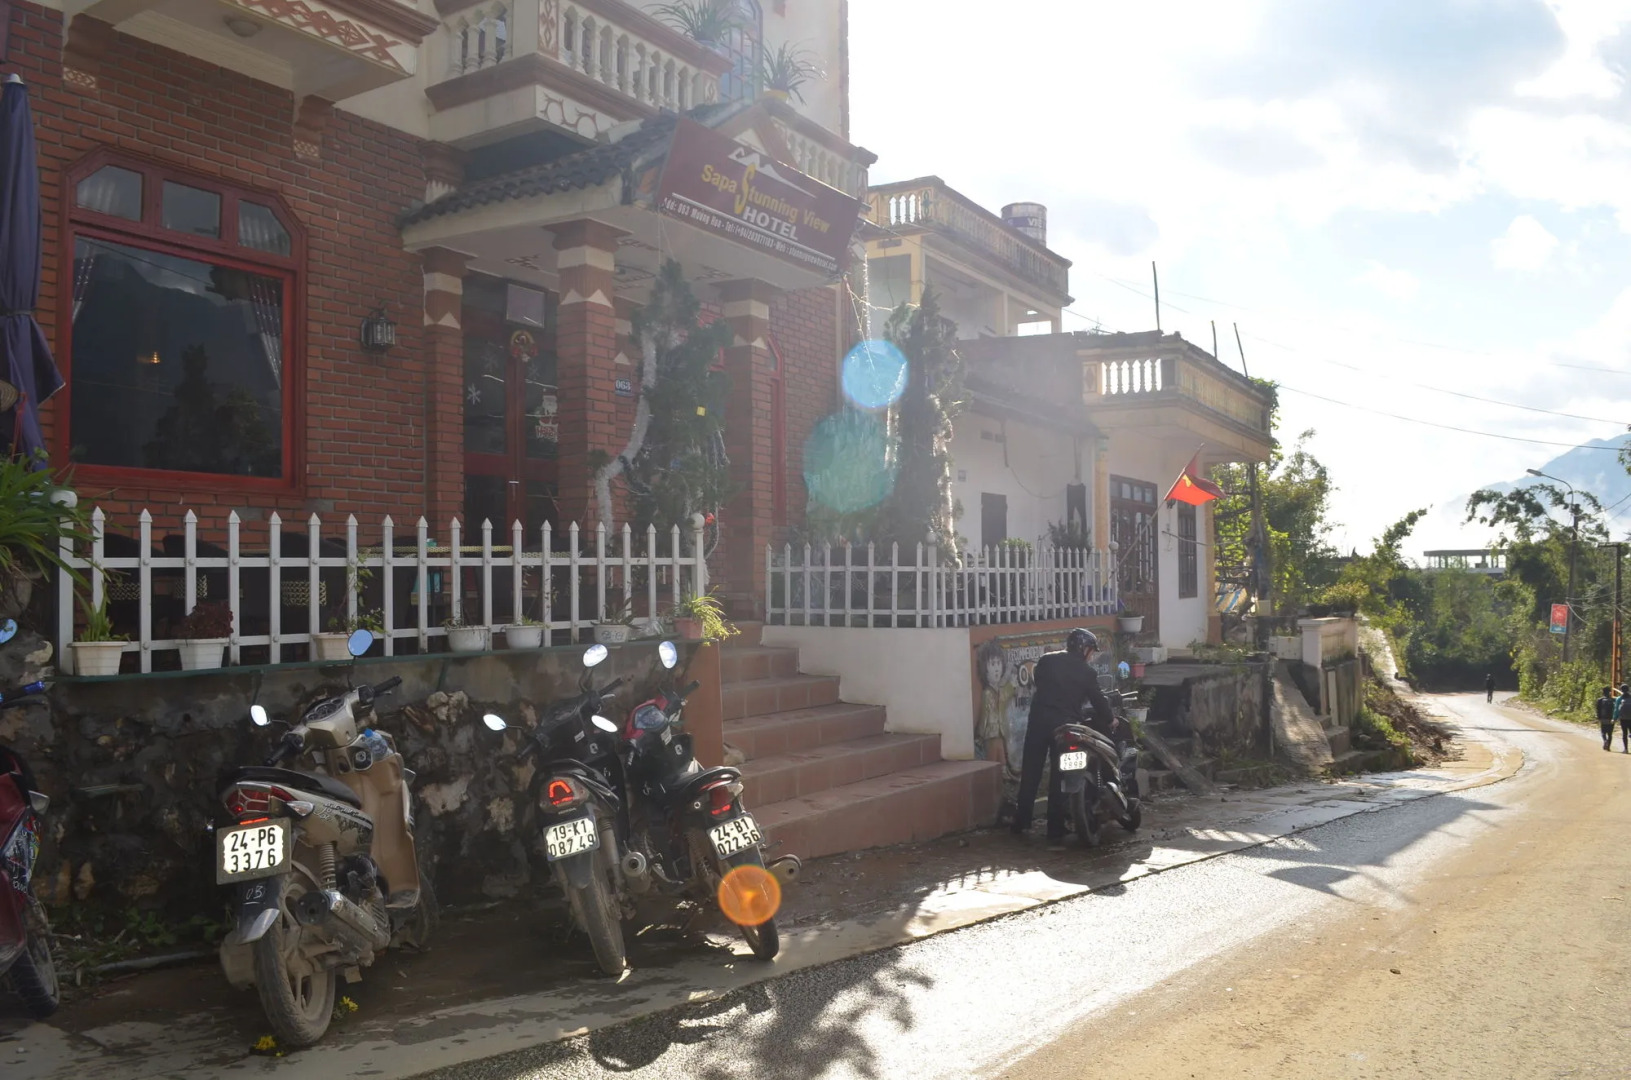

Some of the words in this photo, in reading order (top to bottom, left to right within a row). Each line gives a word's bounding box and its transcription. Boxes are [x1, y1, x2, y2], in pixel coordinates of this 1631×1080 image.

[701, 164, 737, 193] Sapa
[734, 164, 799, 224] Stunning
[803, 209, 831, 233] View
[742, 206, 799, 241] HOTEL
[615, 379, 631, 391] 063
[231, 827, 276, 852] 24-P6
[553, 820, 587, 841] 19-K1
[714, 818, 749, 841] 24-B1
[550, 833, 595, 857] 087.49
[717, 830, 760, 855] 022.56
[231, 848, 276, 873] 3376
